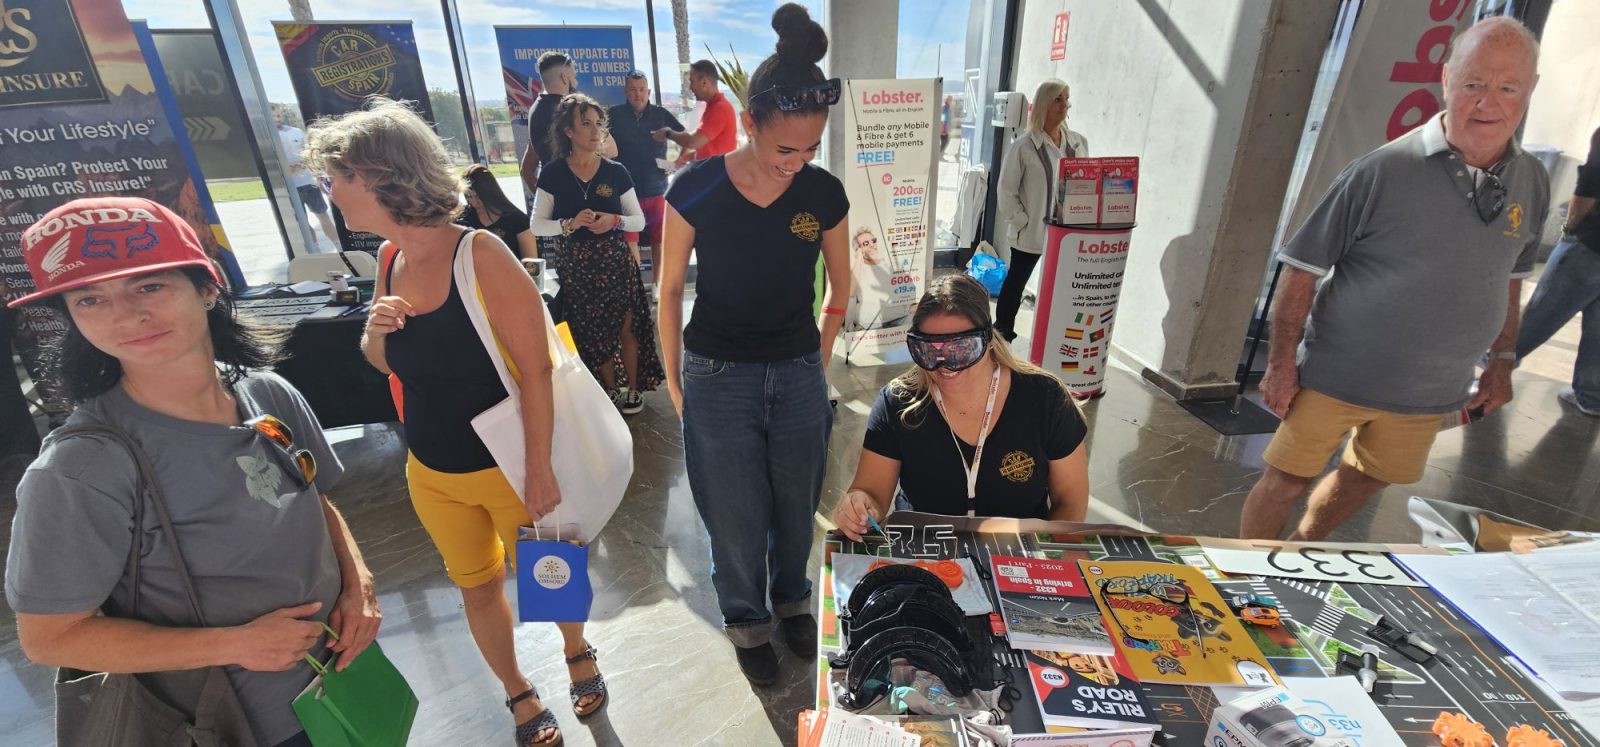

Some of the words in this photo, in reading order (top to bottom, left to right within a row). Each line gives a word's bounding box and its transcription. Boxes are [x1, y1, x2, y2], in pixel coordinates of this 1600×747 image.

[331, 39, 359, 57] CAR
[573, 48, 608, 59] UPDATE
[611, 48, 629, 59] FOR
[320, 51, 389, 81] REGISTRATIONS
[592, 62, 631, 73] OWNERS
[0, 71, 88, 93] INSURE
[349, 73, 380, 91] SPAIN
[593, 76, 604, 86] IN
[606, 76, 626, 87] SPAI
[857, 124, 886, 132] Bundle
[887, 125, 903, 133] any
[904, 121, 930, 130] Mobile
[6, 126, 55, 144] Your
[864, 132, 885, 140] Fibre
[894, 132, 908, 140] get
[857, 141, 885, 149] mobile
[885, 140, 924, 149] payments
[857, 150, 895, 163] FREE!
[14, 162, 67, 183] Spain?
[71, 157, 131, 175] Protect
[131, 156, 168, 172] Your
[16, 181, 50, 199] with
[52, 180, 87, 195] CRS
[893, 197, 922, 208] FREE!
[8, 212, 35, 225] with
[26, 207, 163, 251] HONDA
[1078, 240, 1129, 254] Lobste
[47, 260, 86, 281] HONDA
[1074, 272, 1114, 280] Unlimited
[22, 306, 53, 317] Peace
[28, 320, 65, 332] Health
[1041, 563, 1065, 571] 2025
[1009, 577, 1033, 585] Spain
[1043, 579, 1074, 587] Driving
[1035, 585, 1057, 593] N332
[1043, 673, 1063, 681] N332
[1077, 685, 1138, 702] ROAD
[1071, 698, 1146, 717] RILEY'S
